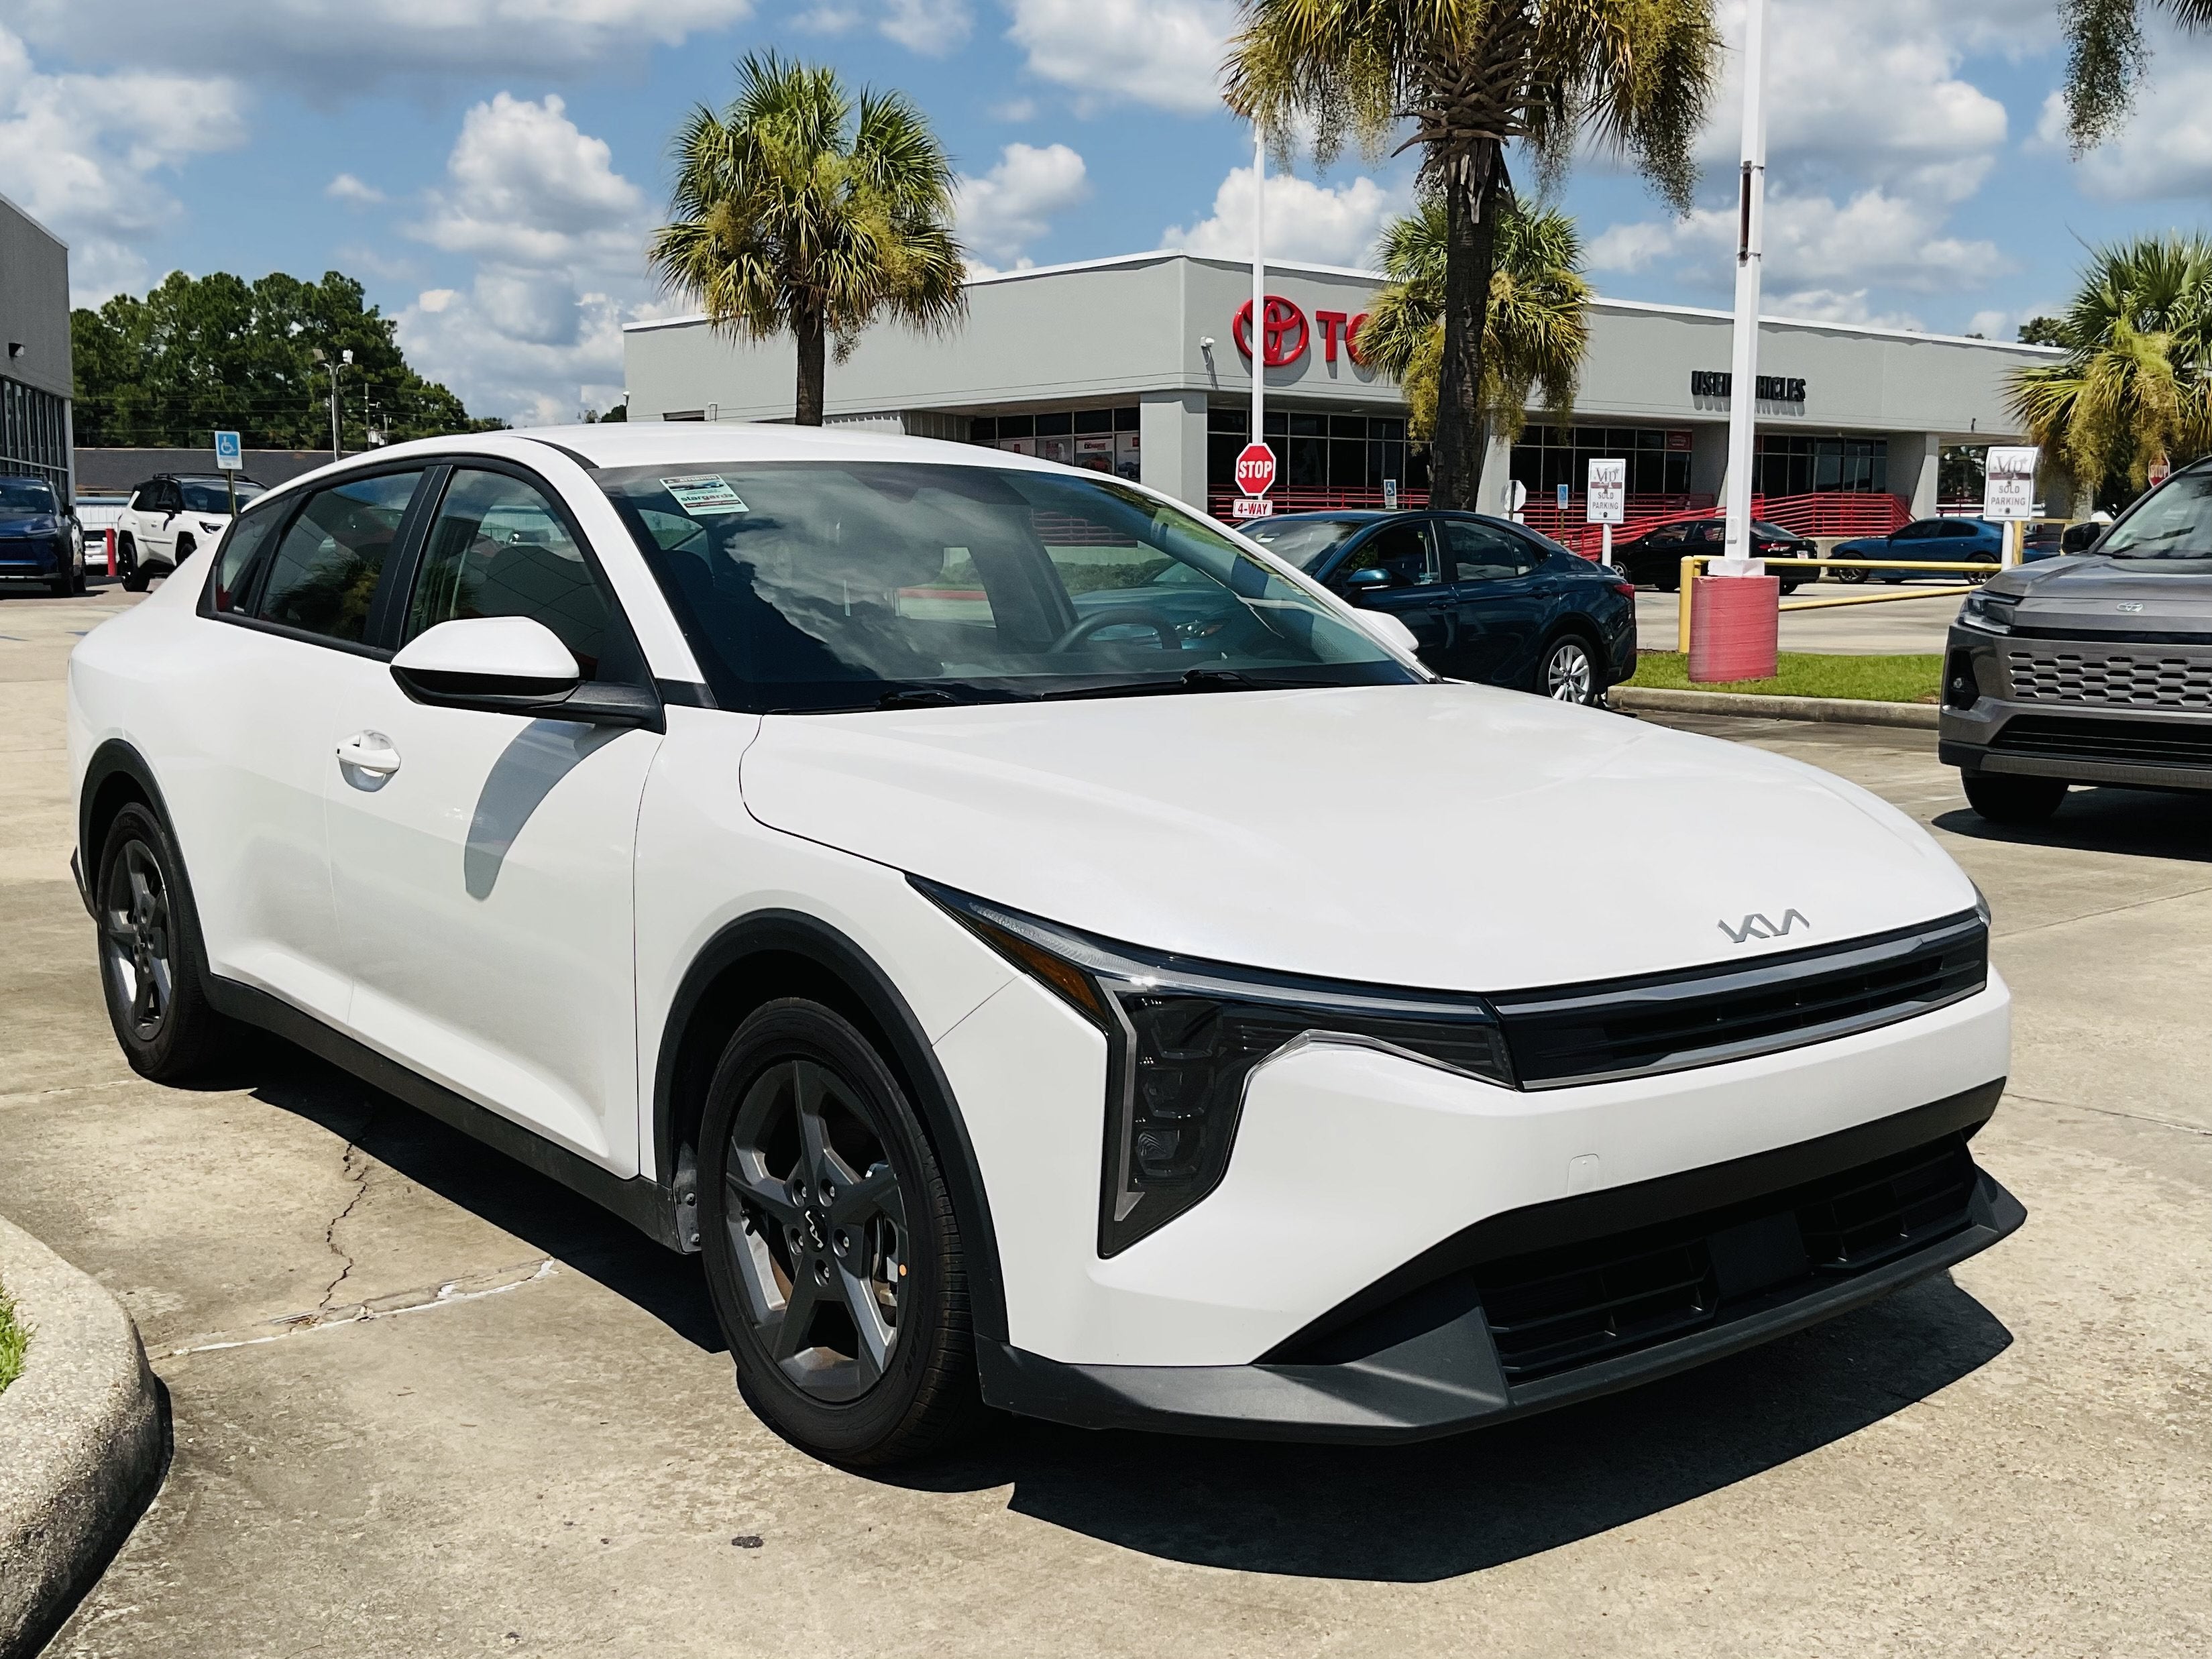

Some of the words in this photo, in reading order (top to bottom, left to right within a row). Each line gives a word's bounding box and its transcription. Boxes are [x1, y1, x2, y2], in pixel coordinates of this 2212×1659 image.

[1756, 376, 1806, 402] HICLES
[1239, 460, 1272, 479] STOP
[1999, 485, 2020, 494] SOLD
[1598, 492, 1614, 500] SOLD
[1592, 502, 1618, 510] PARKING
[1991, 497, 2026, 506] PARKING
[1237, 503, 1268, 515] 4-WAY
[1717, 908, 1810, 943] KIA
